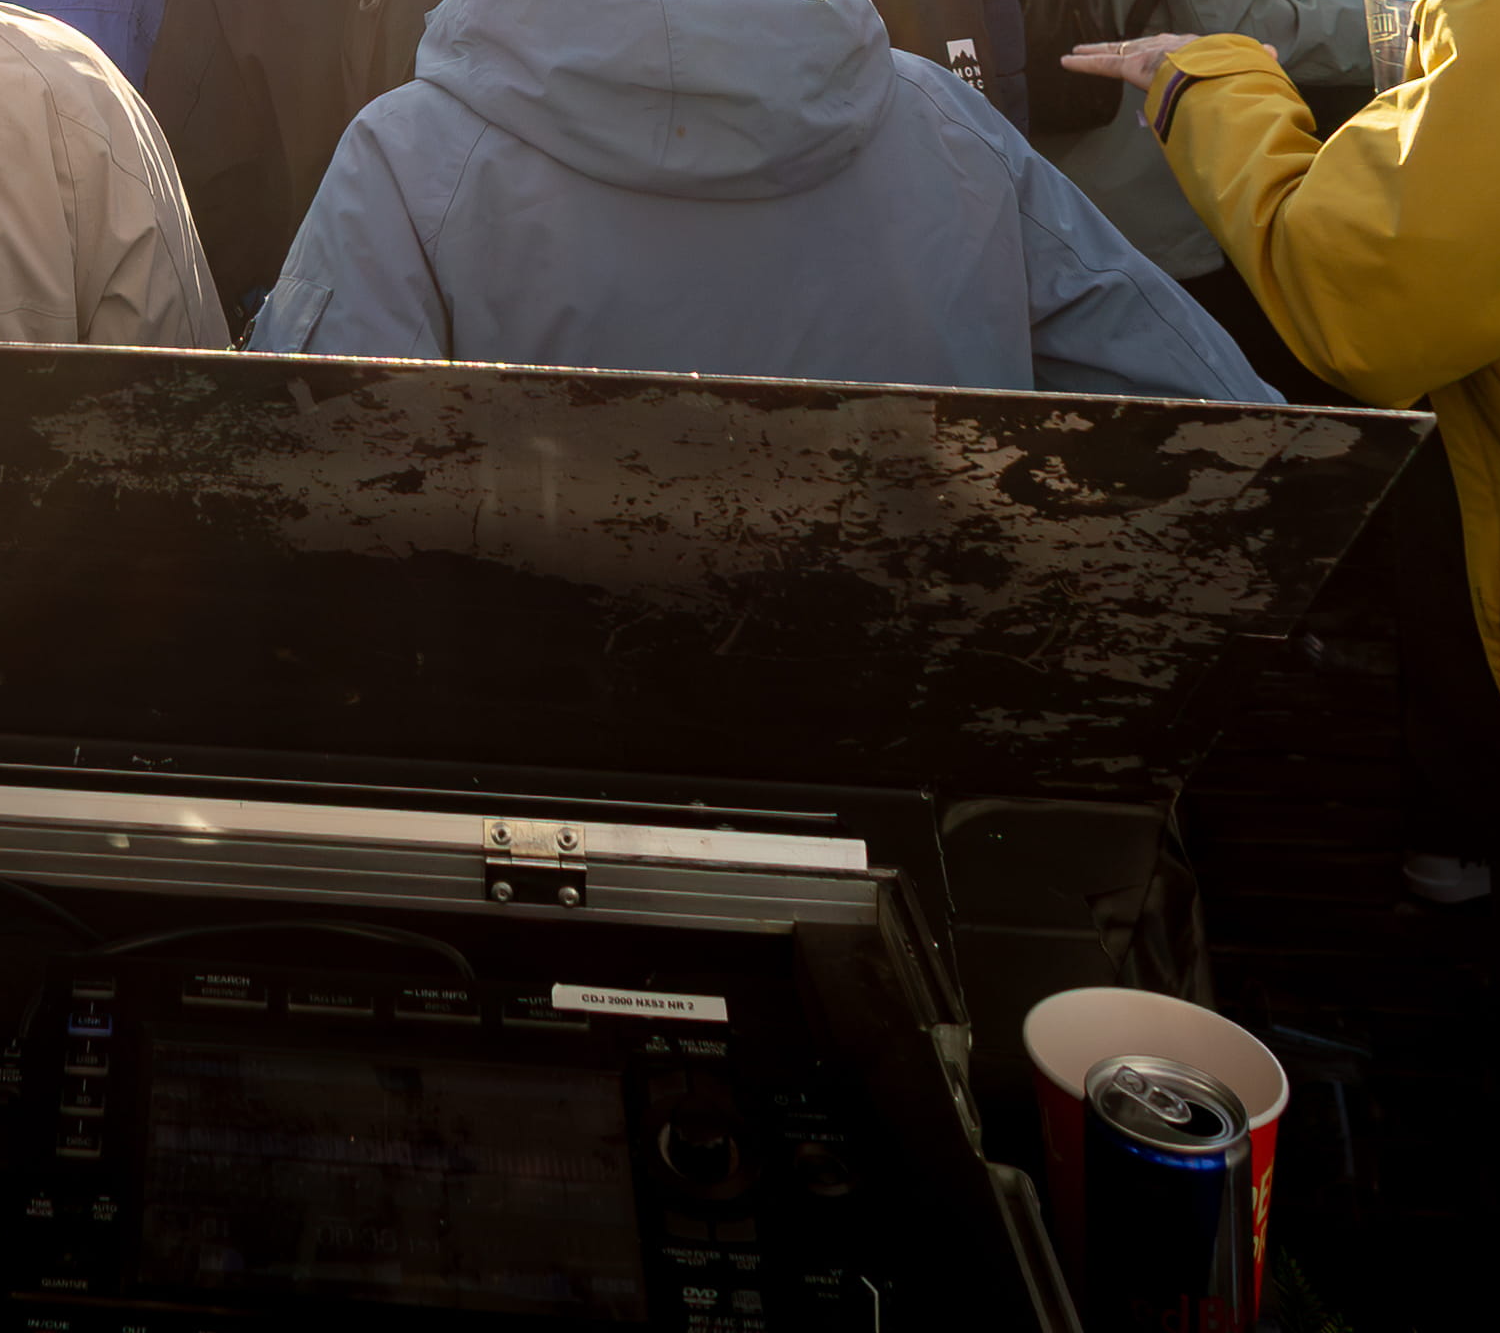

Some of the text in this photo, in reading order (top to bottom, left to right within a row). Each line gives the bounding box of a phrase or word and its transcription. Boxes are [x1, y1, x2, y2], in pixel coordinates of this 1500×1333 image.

[581, 993, 605, 1005] CDJ
[607, 995, 634, 1007] 2000
[667, 999, 686, 1010] NR
